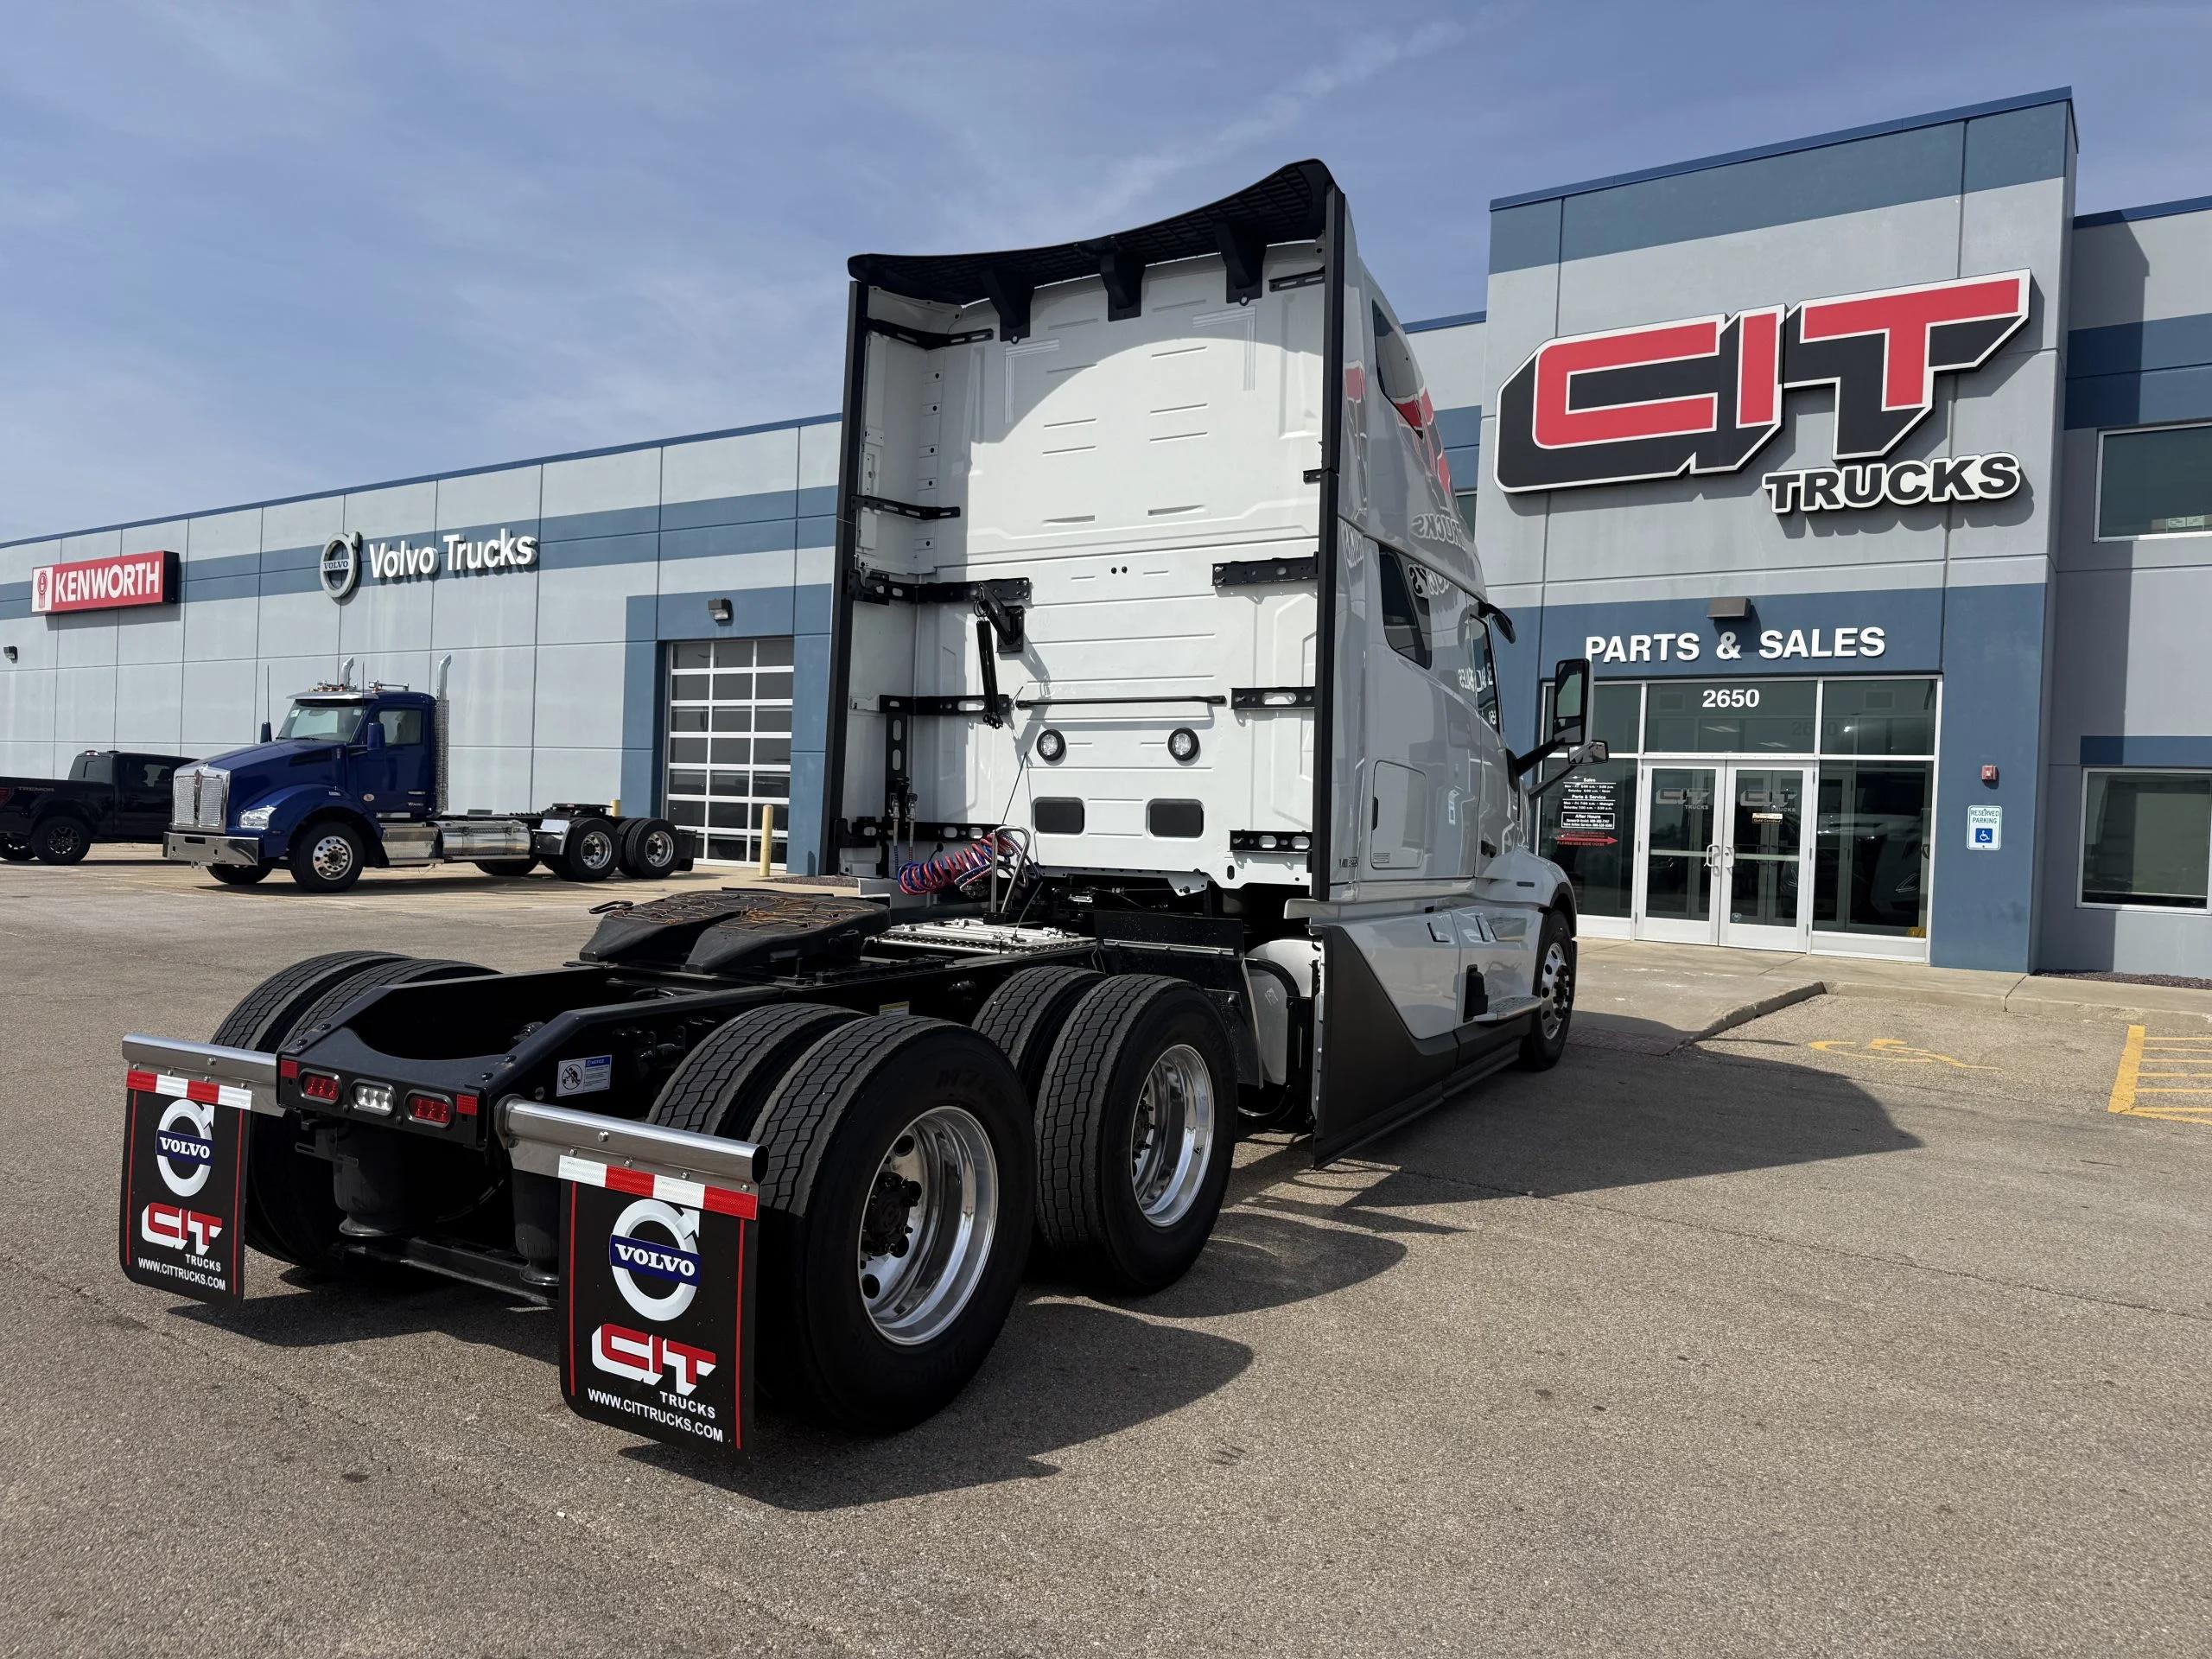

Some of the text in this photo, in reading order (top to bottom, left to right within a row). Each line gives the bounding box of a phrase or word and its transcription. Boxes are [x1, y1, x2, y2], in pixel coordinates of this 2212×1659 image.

[1497, 269, 2031, 489] CIT
[1764, 454, 2019, 512] TRUCKS
[323, 560, 349, 570] VOLVO
[369, 528, 537, 579] Volvo Trucks
[55, 561, 159, 603] KENWORTH
[1585, 626, 1886, 664] PARTS & SALES
[1702, 689, 1760, 709] 2650
[160, 1136, 211, 1160] VOLVO
[142, 1202, 222, 1255] CIT
[138, 1257, 226, 1291] WWW.CITTRUCKS.COM
[185, 1254, 221, 1272] TRUCKS
[614, 1243, 696, 1277] VOLVO
[592, 1323, 716, 1395] CIT
[588, 1388, 723, 1442] WWW.CITTRUCKS.COM
[659, 1391, 715, 1419] TRUCKS
